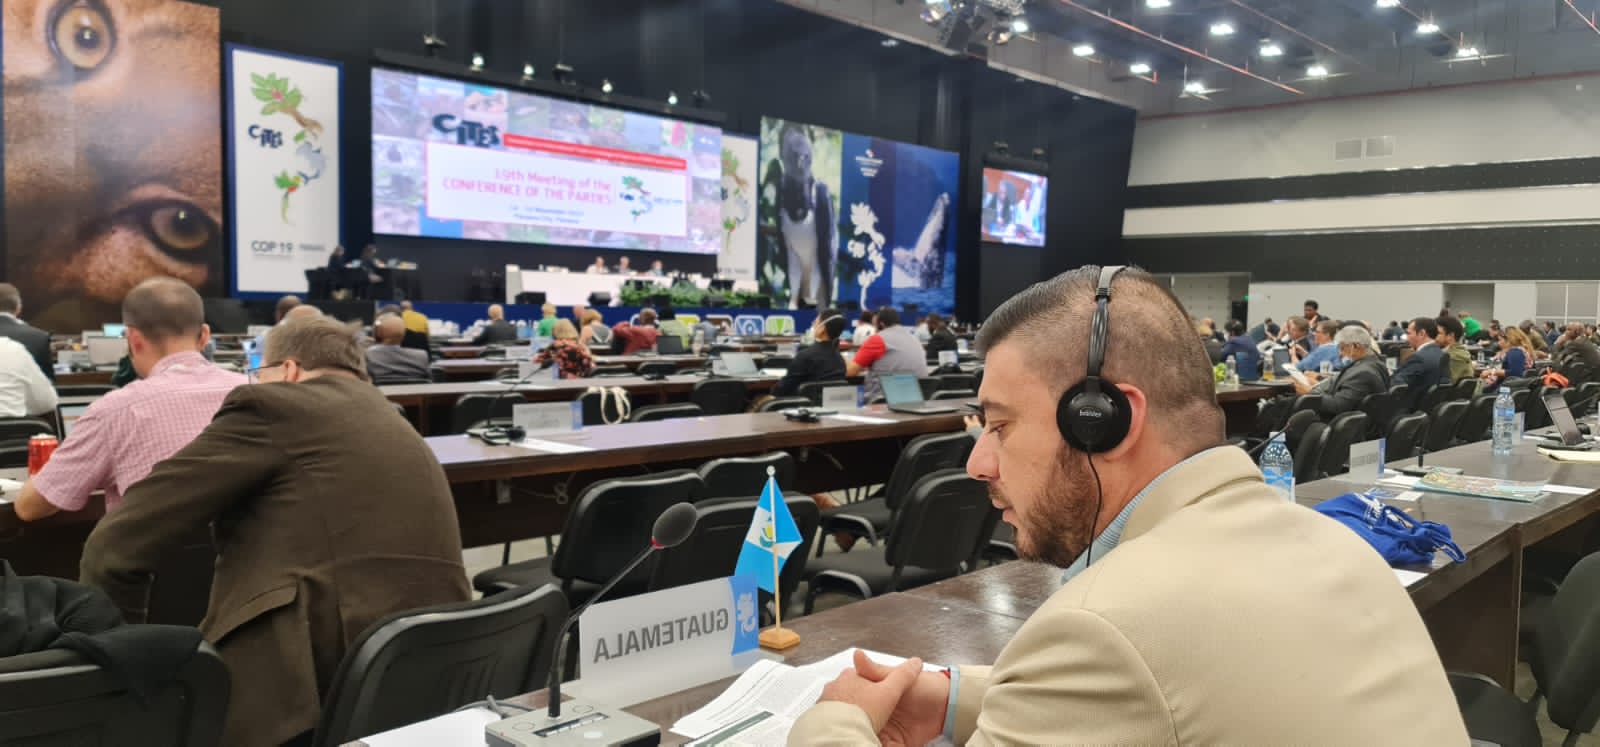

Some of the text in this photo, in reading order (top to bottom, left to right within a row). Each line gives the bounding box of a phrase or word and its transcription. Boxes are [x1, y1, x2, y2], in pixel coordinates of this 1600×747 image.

[432, 113, 500, 148] CITES
[442, 176, 521, 198] CONFERENCE
[525, 185, 539, 197] OF
[544, 187, 565, 201] THE
[568, 190, 614, 206] PARTIES
[527, 172, 576, 190] Meeting
[578, 178, 591, 189] of
[593, 179, 611, 192] the
[251, 240, 277, 252] COP
